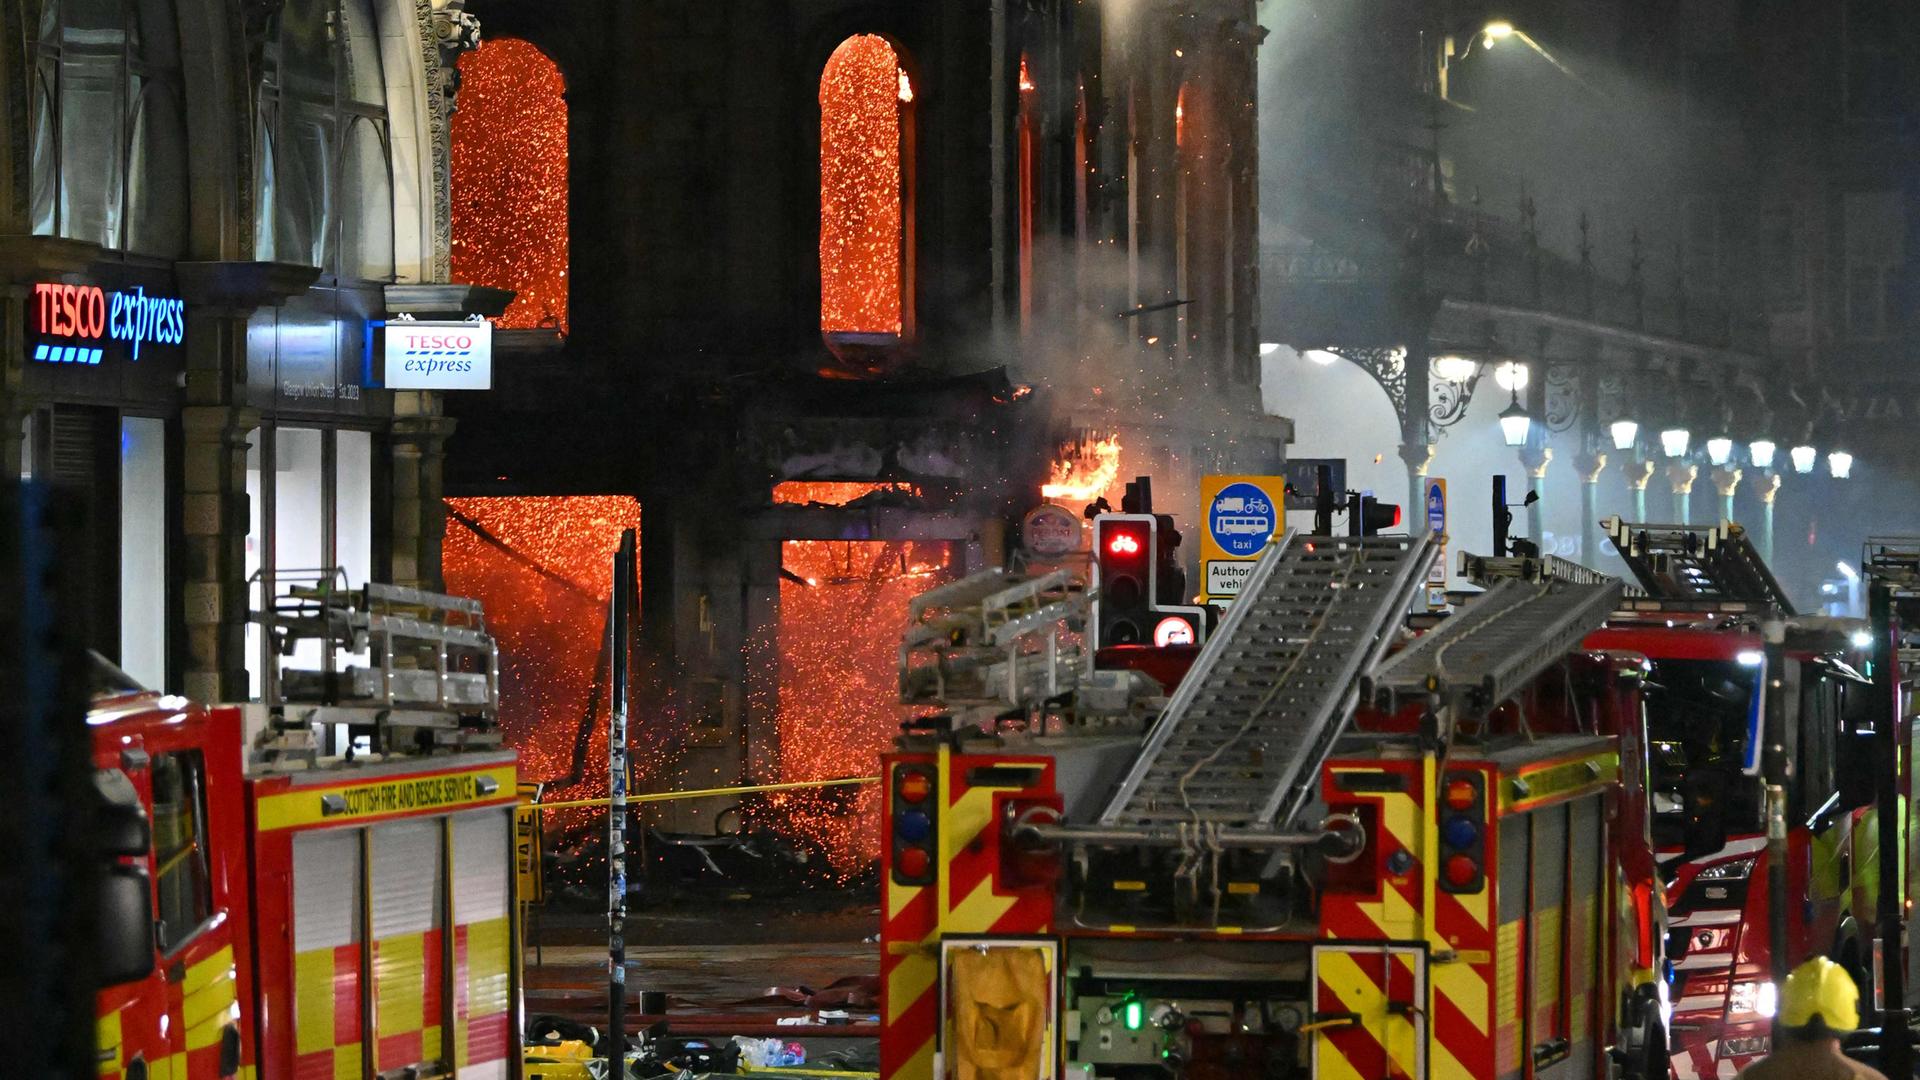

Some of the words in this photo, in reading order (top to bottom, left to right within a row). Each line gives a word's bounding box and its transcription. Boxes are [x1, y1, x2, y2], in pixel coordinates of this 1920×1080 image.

[35, 283, 105, 339] TESCO
[110, 286, 184, 360] express
[405, 335, 472, 349] TESCO
[404, 358, 472, 376] express
[1233, 540, 1252, 549] taxi
[1212, 566, 1250, 576] Author
[1220, 579, 1242, 588] vehi
[344, 786, 380, 815] SCOTTISH
[381, 785, 397, 810] FIRE
[399, 783, 414, 808] AND
[415, 779, 442, 807] RESCUE
[444, 775, 472, 802] SERVICE
